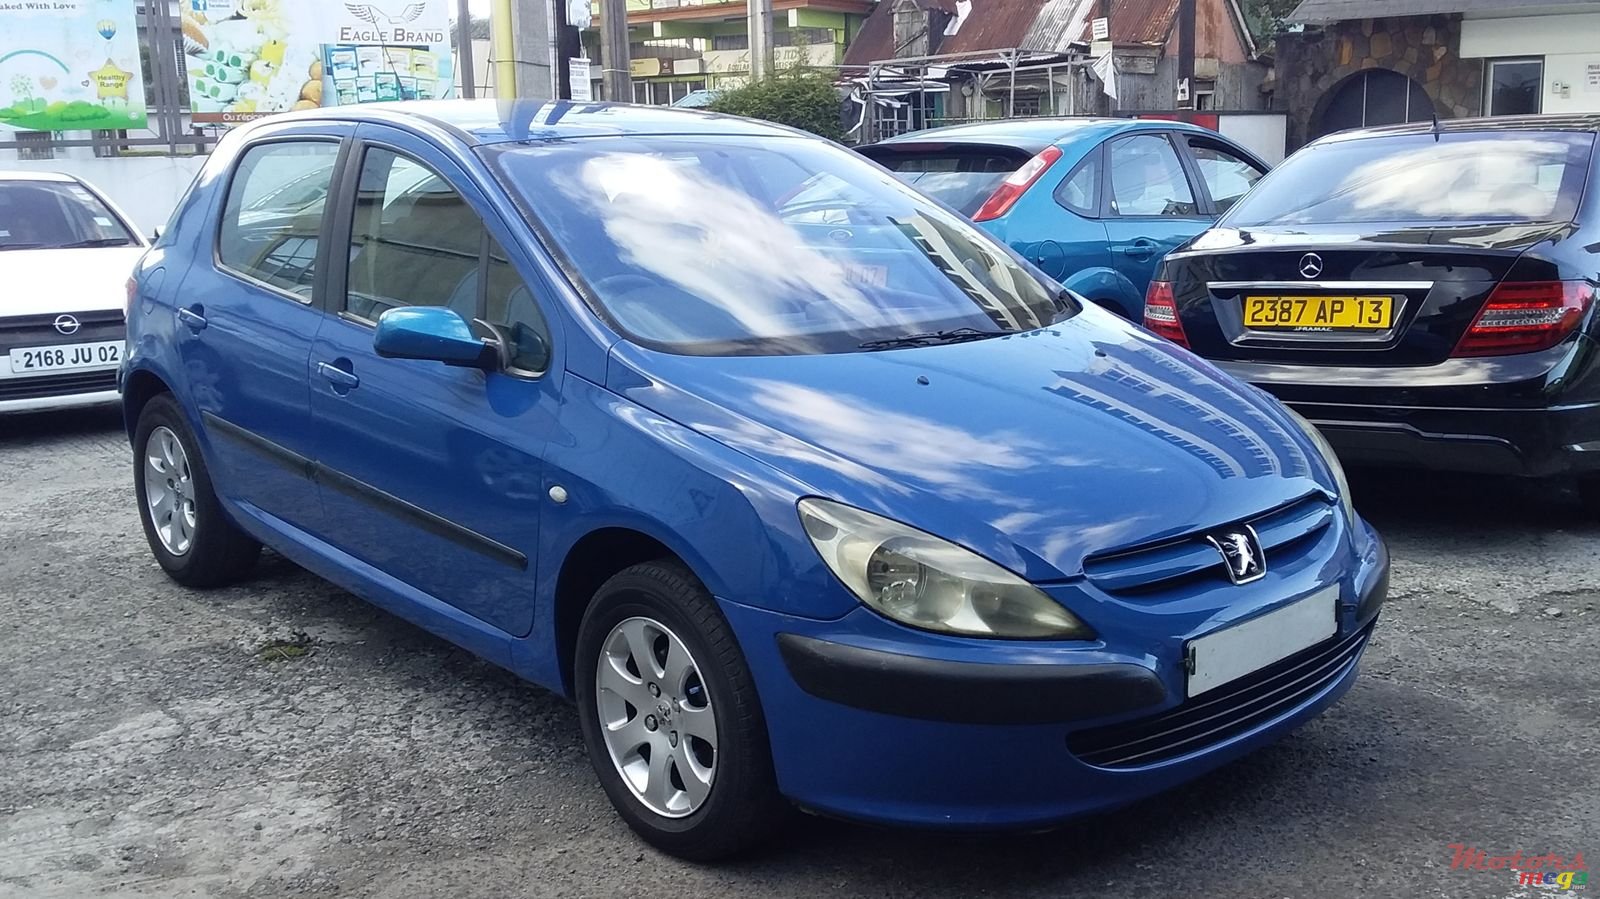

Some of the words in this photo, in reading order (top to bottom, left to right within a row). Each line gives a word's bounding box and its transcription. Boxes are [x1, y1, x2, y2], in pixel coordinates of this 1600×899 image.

[53, 2, 76, 10] Love
[393, 28, 443, 43] BRAND
[97, 74, 126, 82] Healthy
[99, 81, 123, 89] Range
[1251, 300, 1308, 323] 2387
[1314, 300, 1345, 323] AP
[1357, 300, 1384, 324] 13
[23, 349, 65, 369] 2168
[70, 347, 92, 364] JU
[98, 345, 119, 362] 02
